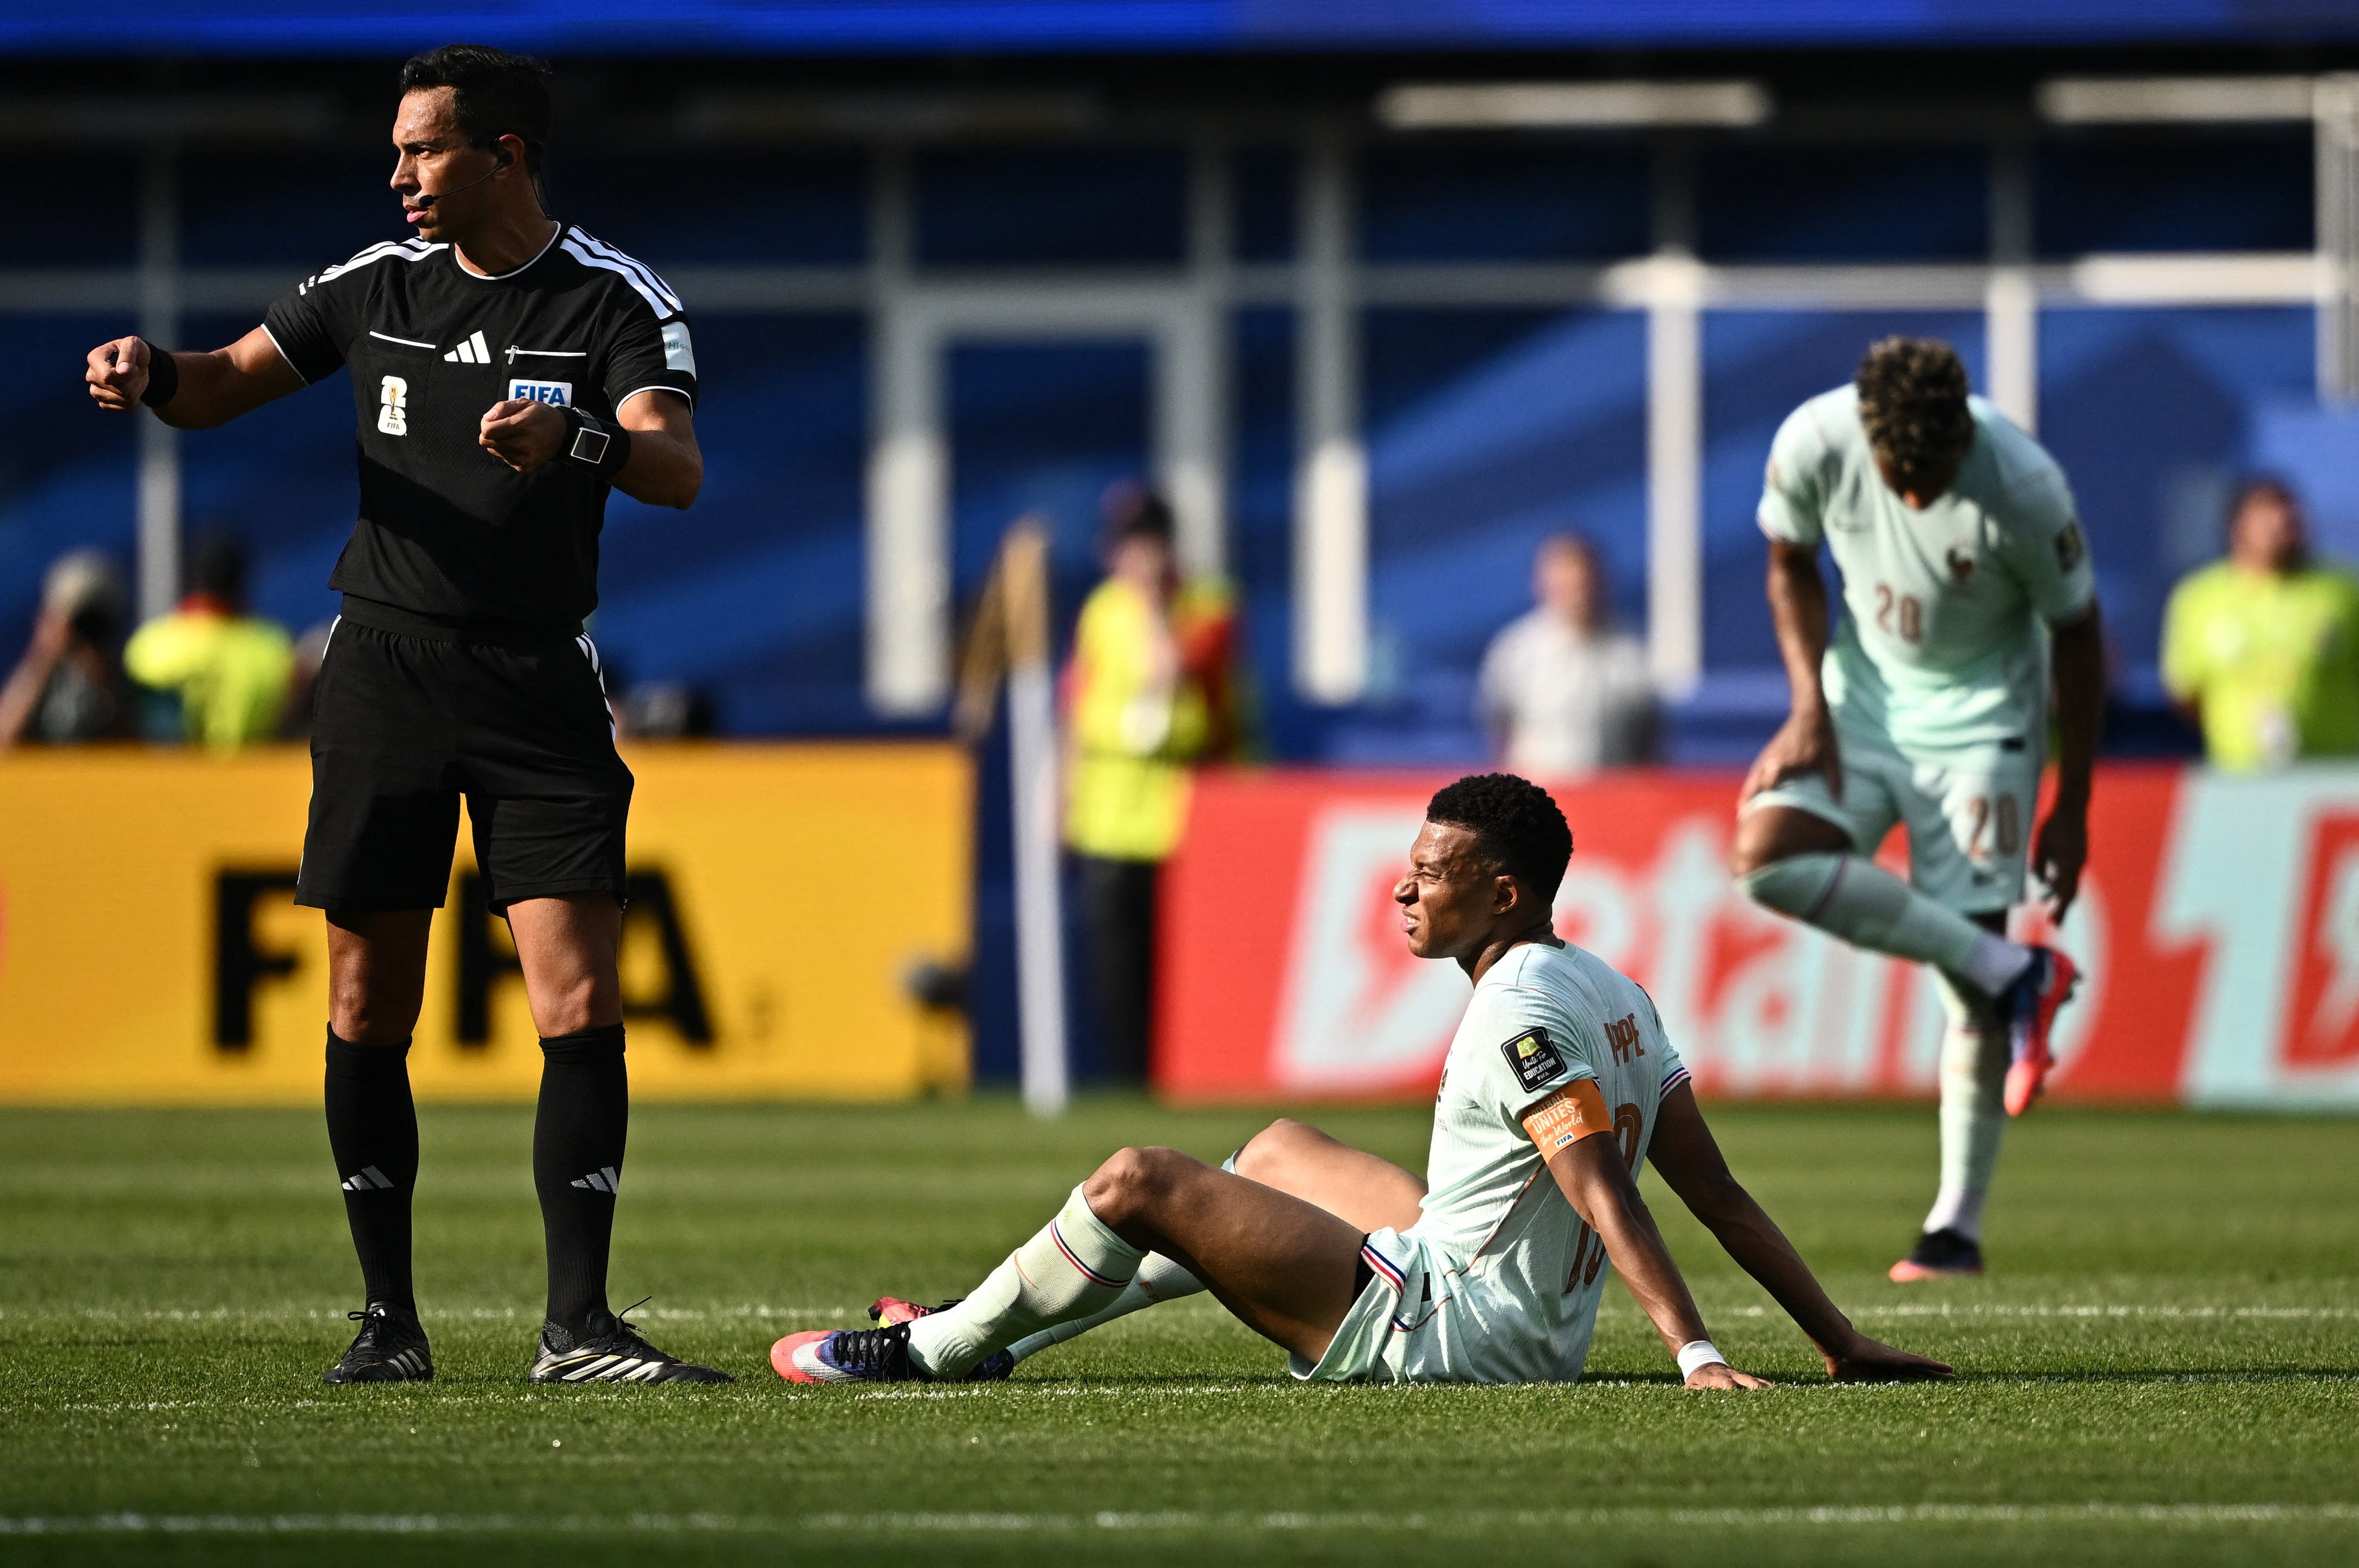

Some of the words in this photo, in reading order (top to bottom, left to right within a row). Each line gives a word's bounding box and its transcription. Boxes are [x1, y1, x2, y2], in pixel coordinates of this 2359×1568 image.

[514, 385, 565, 405] FIFA
[1874, 580, 1922, 644] 20
[1967, 794, 2019, 858] 20
[218, 864, 717, 1048] FFA
[1267, 800, 2106, 1092] Btano
[1522, 1056, 1538, 1069] Unite
[1536, 1051, 1546, 1061] For
[1523, 1057, 1556, 1080] EDUCATION
[1537, 1072, 1550, 1081] FIFA
[1528, 1092, 1569, 1123] FOOTBALL
[1532, 1100, 1576, 1134] UNITES
[1539, 1133, 1554, 1147] the
[1552, 1111, 1584, 1136] World
[1556, 1134, 1573, 1146] FIFA
